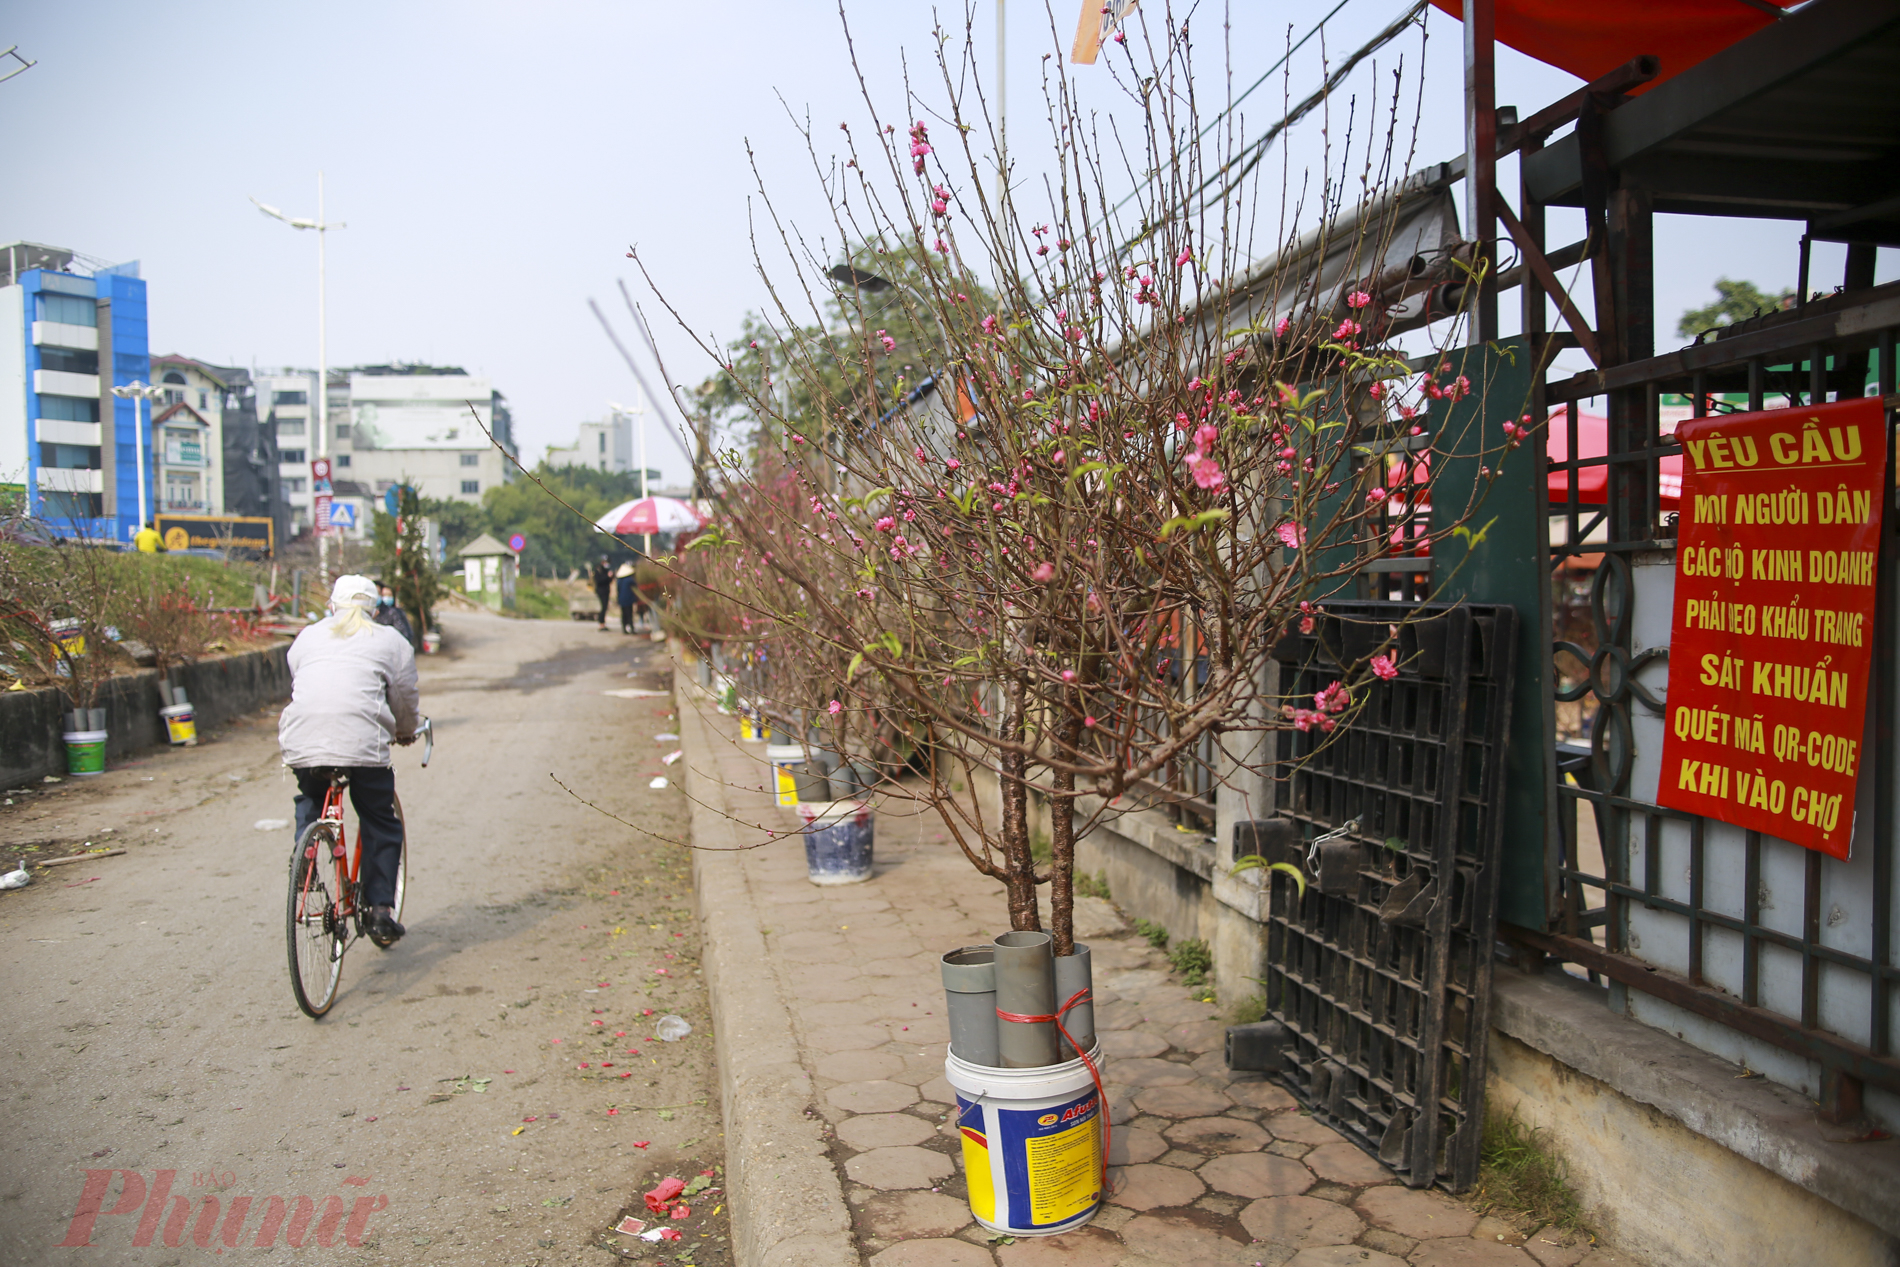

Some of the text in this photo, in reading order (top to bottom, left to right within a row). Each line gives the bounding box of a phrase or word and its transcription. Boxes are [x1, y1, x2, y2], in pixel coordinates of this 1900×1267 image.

[1686, 416, 1862, 471] YÊU CẦU
[1693, 483, 1871, 531] MỌI NGƯỜI DÂN
[1682, 540, 1874, 587] CÁC HỘ KINH DOANH
[1685, 590, 1726, 632] PHẢI
[1761, 593, 1810, 641] KHẨU
[1814, 609, 1864, 648] TRANG
[1699, 649, 1849, 709] SÁT KHUẨN
[1674, 704, 1857, 777] QUÉT MÃ QR-CODE
[1678, 758, 1843, 840] KHI VÀO CHỢ
